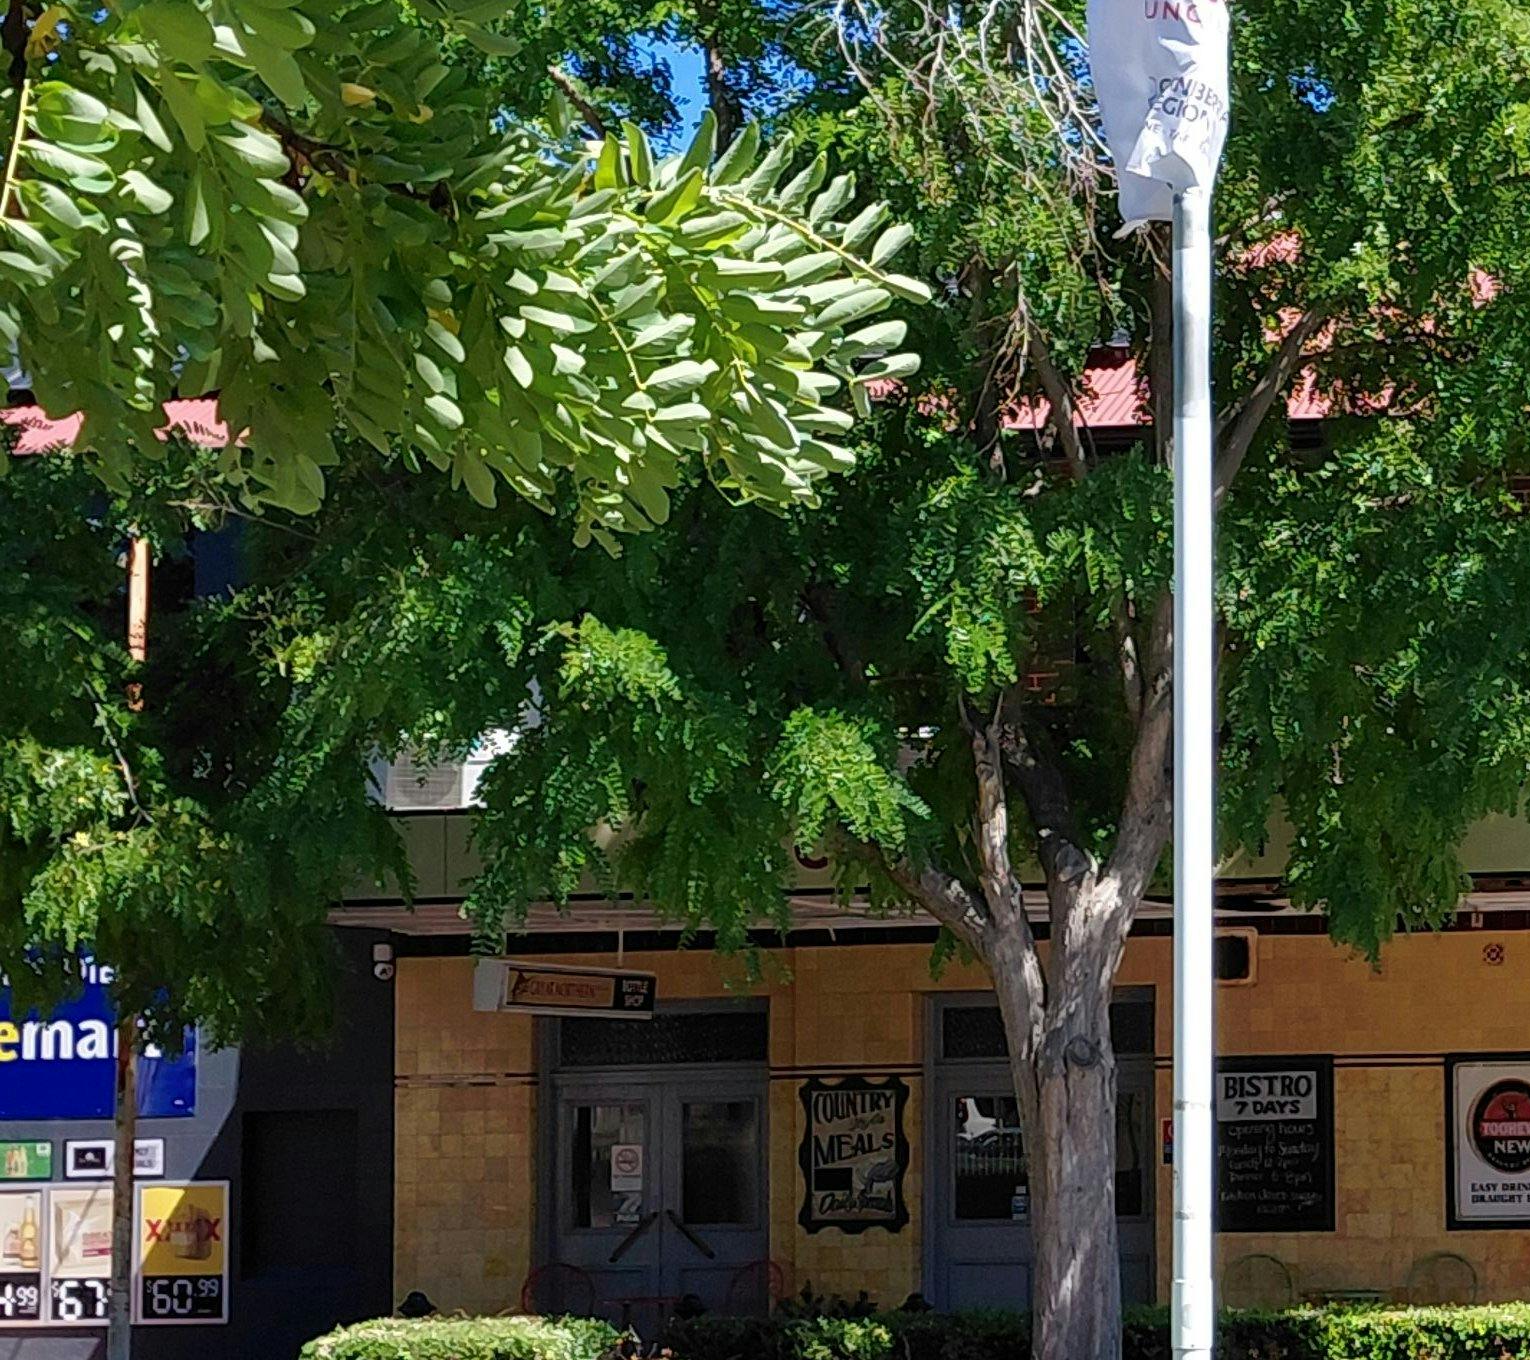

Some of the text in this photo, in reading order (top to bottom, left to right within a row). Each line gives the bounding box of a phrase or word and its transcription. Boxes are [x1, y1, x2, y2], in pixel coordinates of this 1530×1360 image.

[1223, 1075, 1313, 1099] BISTRO
[813, 1091, 894, 1124] COUNTRY
[1233, 1100, 1300, 1115] 7 DAYS
[813, 1133, 895, 1168] MEALS
[1471, 1183, 1499, 1193] EASY
[1471, 1195, 1524, 1204] DRAUGHT
